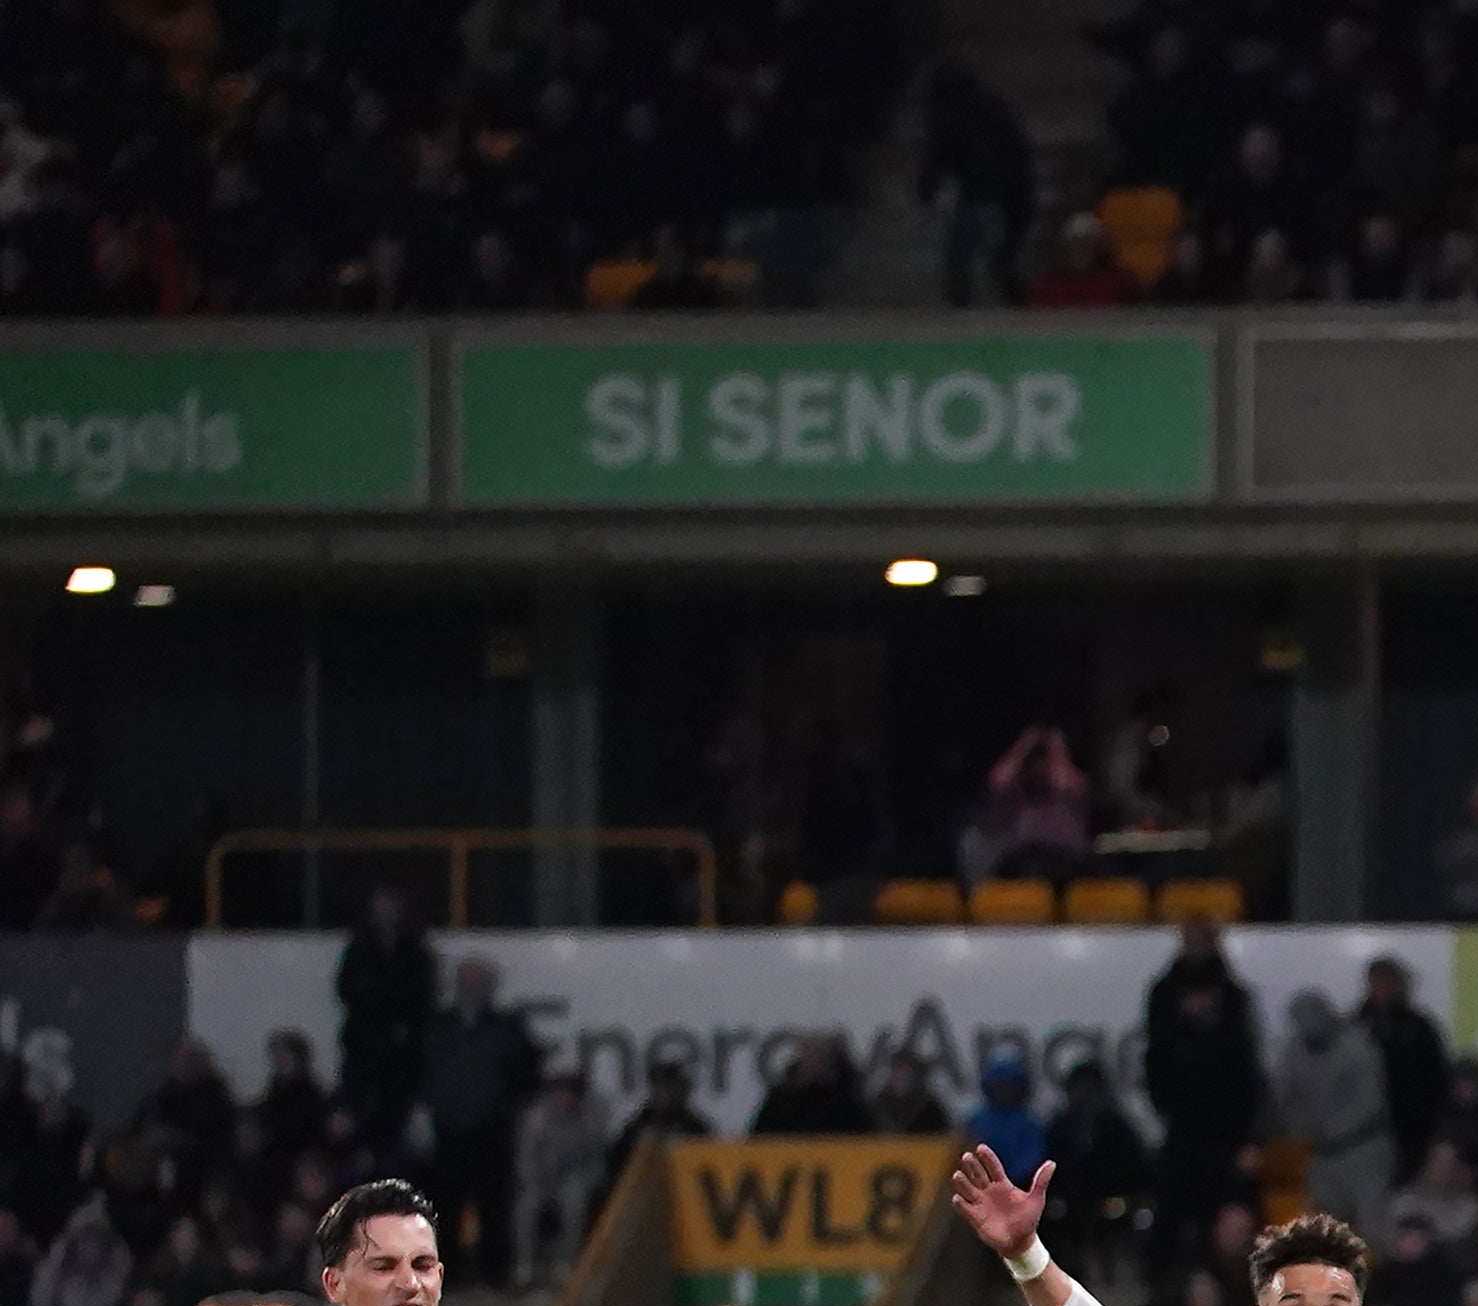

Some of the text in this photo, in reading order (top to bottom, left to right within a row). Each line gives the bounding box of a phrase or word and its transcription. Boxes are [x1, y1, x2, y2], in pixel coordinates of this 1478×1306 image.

[586, 369, 1082, 466] SI SENOR
[697, 1162, 920, 1244] WL8
